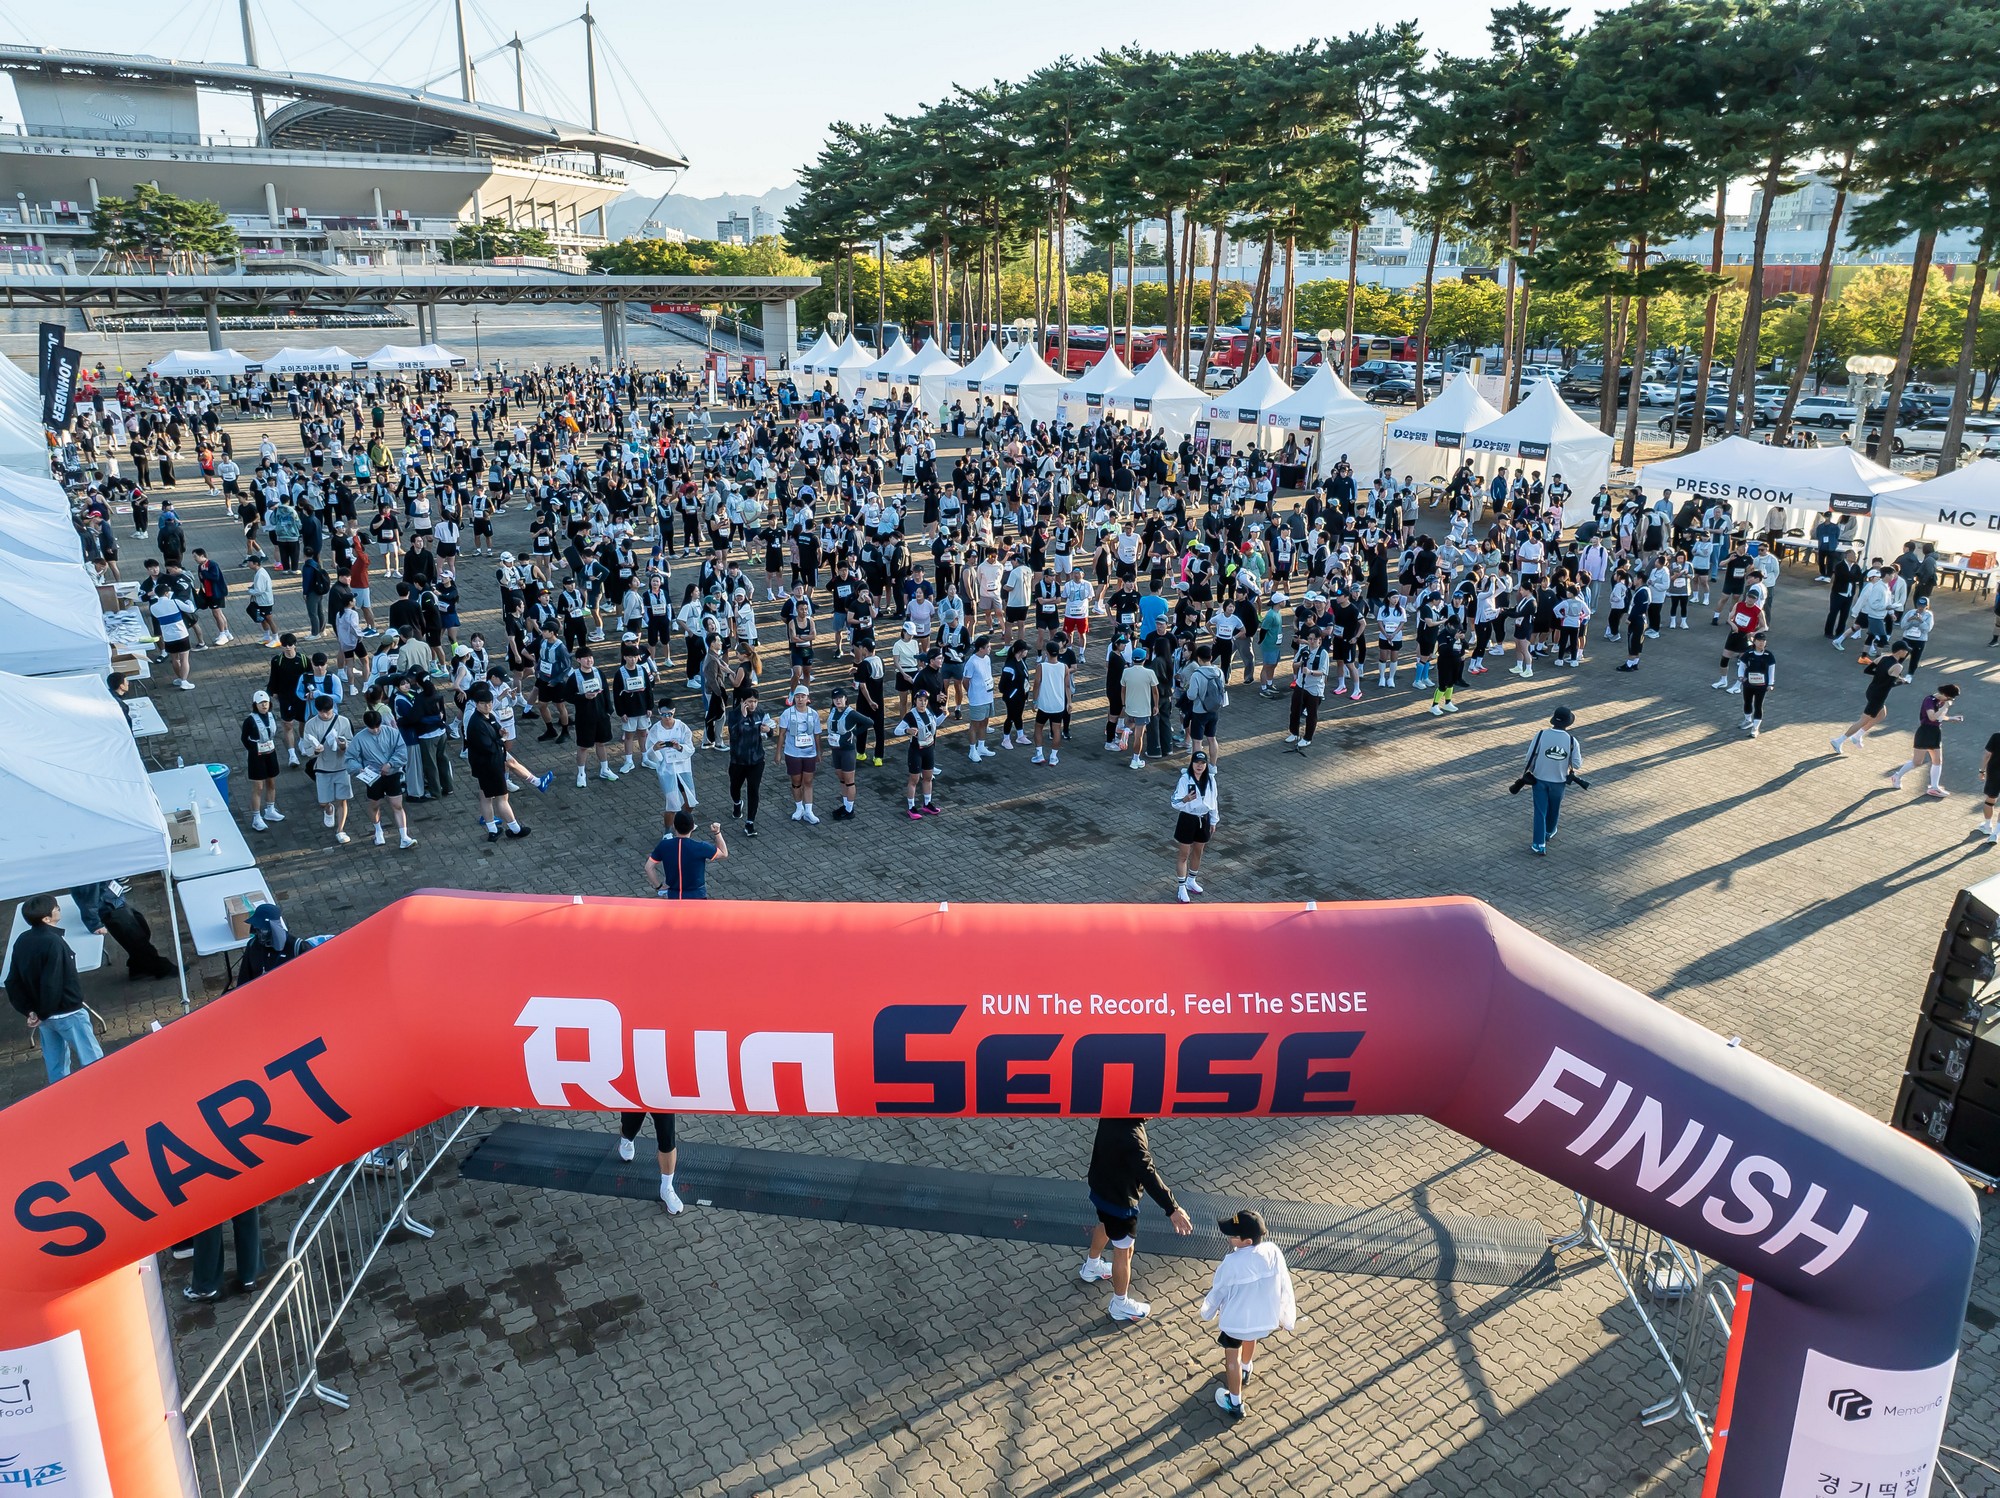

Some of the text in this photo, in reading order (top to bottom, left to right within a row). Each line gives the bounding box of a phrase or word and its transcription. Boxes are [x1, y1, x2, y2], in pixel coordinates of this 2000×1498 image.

[187, 368, 211, 376] URun
[280, 363, 340, 372] 포이즈마라톤클럽
[51, 357, 73, 422] JOHNBER
[1676, 478, 1793, 504] PRESS ROOM
[1938, 508, 1976, 527] MC
[981, 991, 1368, 1017] RUN The Record, Feel The SENSE
[14, 1036, 352, 1257] START
[1504, 1046, 1869, 1276] FINISH
[1818, 1473, 1920, 1498] 경기떡집
